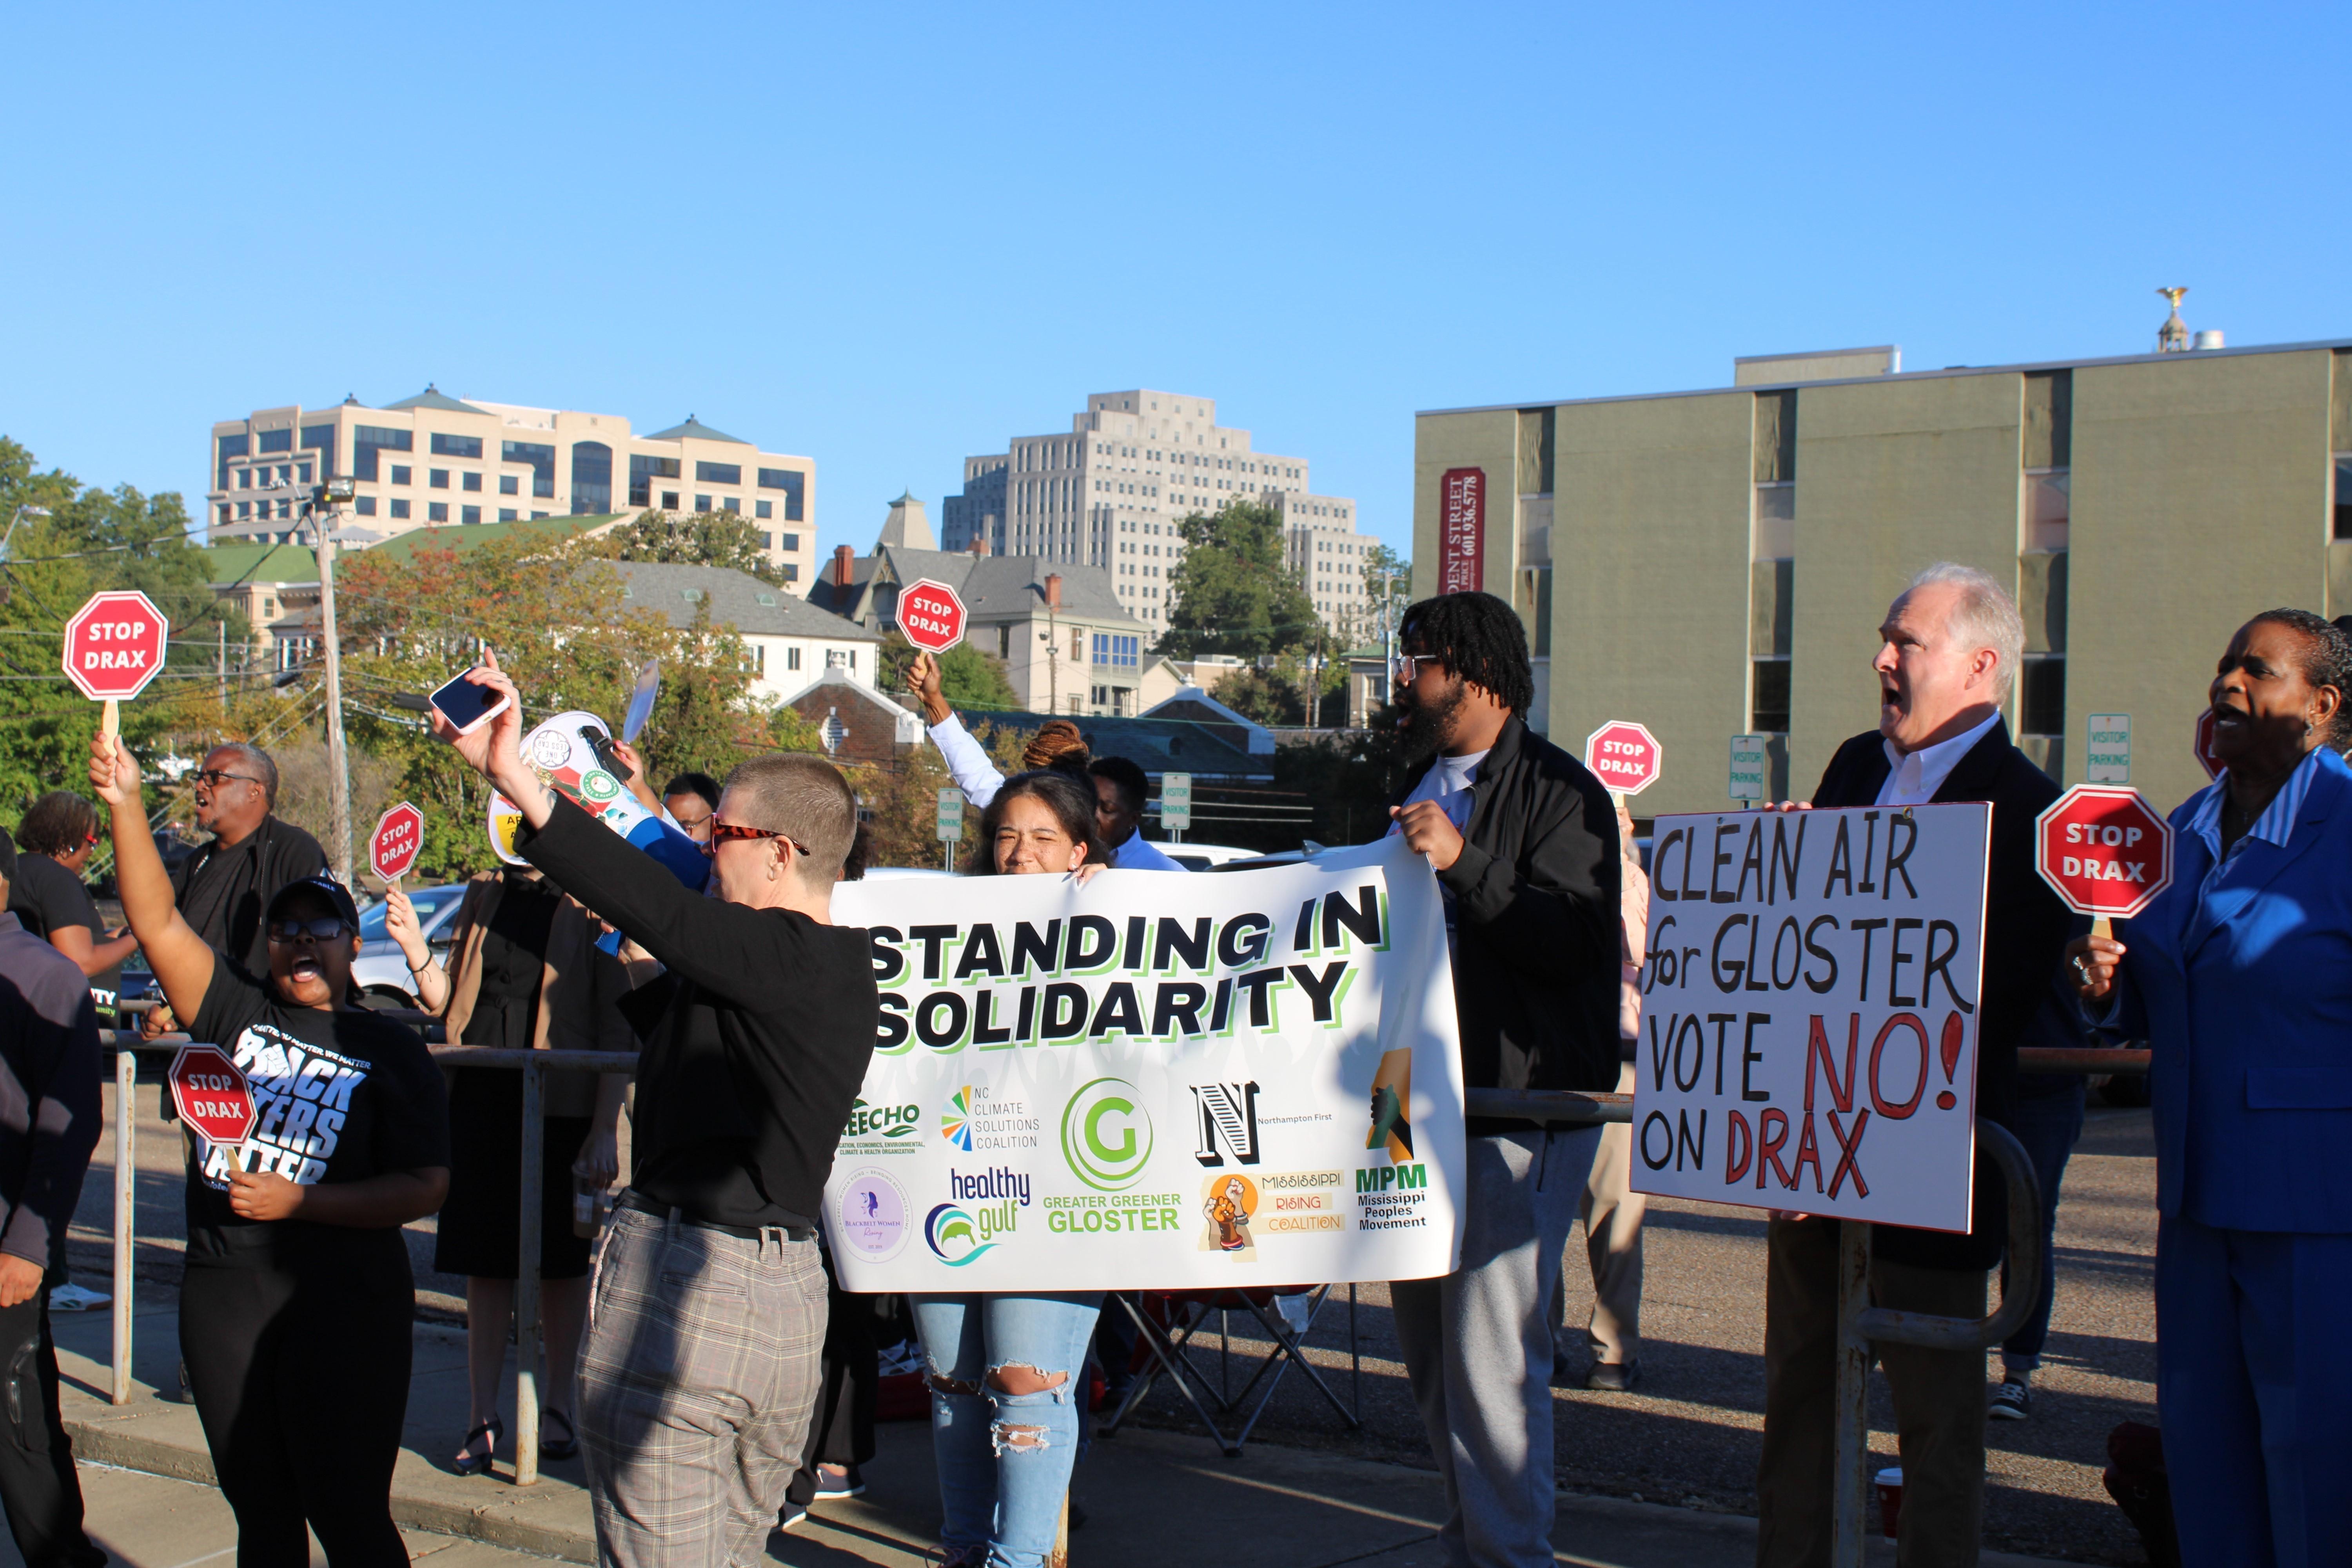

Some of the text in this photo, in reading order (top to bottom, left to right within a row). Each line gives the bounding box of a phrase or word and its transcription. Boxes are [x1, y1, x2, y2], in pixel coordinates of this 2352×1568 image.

[1448, 477, 1463, 544] STREET
[1462, 475, 1477, 556] 601.936.5778
[913, 597, 952, 617] STOP
[89, 621, 145, 641] STOP
[909, 613, 951, 637] DRAX
[85, 650, 146, 670] DRAX
[537, 740, 566, 751] LESS CAR
[2091, 731, 2127, 743] VISITOR
[545, 750, 557, 759] ONE
[1603, 740, 1645, 757] STOP
[1733, 752, 1762, 763] VISITOR
[2089, 754, 2129, 766] PARKING
[1600, 758, 1645, 776] DRAX
[1731, 772, 1762, 783] PARKING
[1166, 787, 1188, 797] VISITOR
[940, 802, 960, 811] VISITOR
[1163, 805, 1188, 815] PARKING
[938, 818, 960, 827] PARKING
[382, 820, 412, 846] STOP
[2066, 822, 2143, 848] STOP
[381, 838, 413, 865] DRAX
[1653, 810, 1918, 906] CLEAN AIR
[2063, 856, 2145, 883] DRAX
[867, 885, 1385, 983] STANDING IN
[1644, 913, 1974, 1014] for GLOSTER
[876, 961, 1350, 1050] SOLIDARITY
[325, 1049, 339, 1060] WE
[338, 1054, 372, 1069] MATTER.
[1649, 1010, 1964, 1120] VOTE NO!
[188, 1074, 232, 1091] STOP
[975, 1087, 989, 1099] NC
[193, 1100, 244, 1119] DRAX
[975, 1102, 1024, 1116] CLIMATE
[841, 1104, 920, 1137] EECHO
[975, 1118, 1040, 1132] SOLUTIONS
[1258, 1116, 1312, 1125] Northampton
[976, 1136, 1037, 1149] COALITION
[1641, 1107, 1871, 1201] ON DRAX
[951, 1166, 1031, 1207] healthy
[1261, 1173, 1340, 1189] MISSISSIPPI
[1356, 1163, 1427, 1193] MPM
[839, 1181, 851, 1199] WOMEN
[850, 1171, 865, 1181] RISING
[870, 1170, 892, 1183] BRINGING
[893, 1181, 909, 1212] RESOURCES
[1358, 1191, 1425, 1206] Mississippi
[1043, 1193, 1182, 1209] GREATER GREENER
[1276, 1196, 1321, 1210] RISING
[978, 1199, 1018, 1241] gulf
[1048, 1208, 1181, 1233] GLOSTER
[1365, 1205, 1412, 1220] Peoples
[1269, 1216, 1340, 1231] COALITION
[1359, 1216, 1426, 1230] Movement
[864, 1227, 883, 1240] Rising
